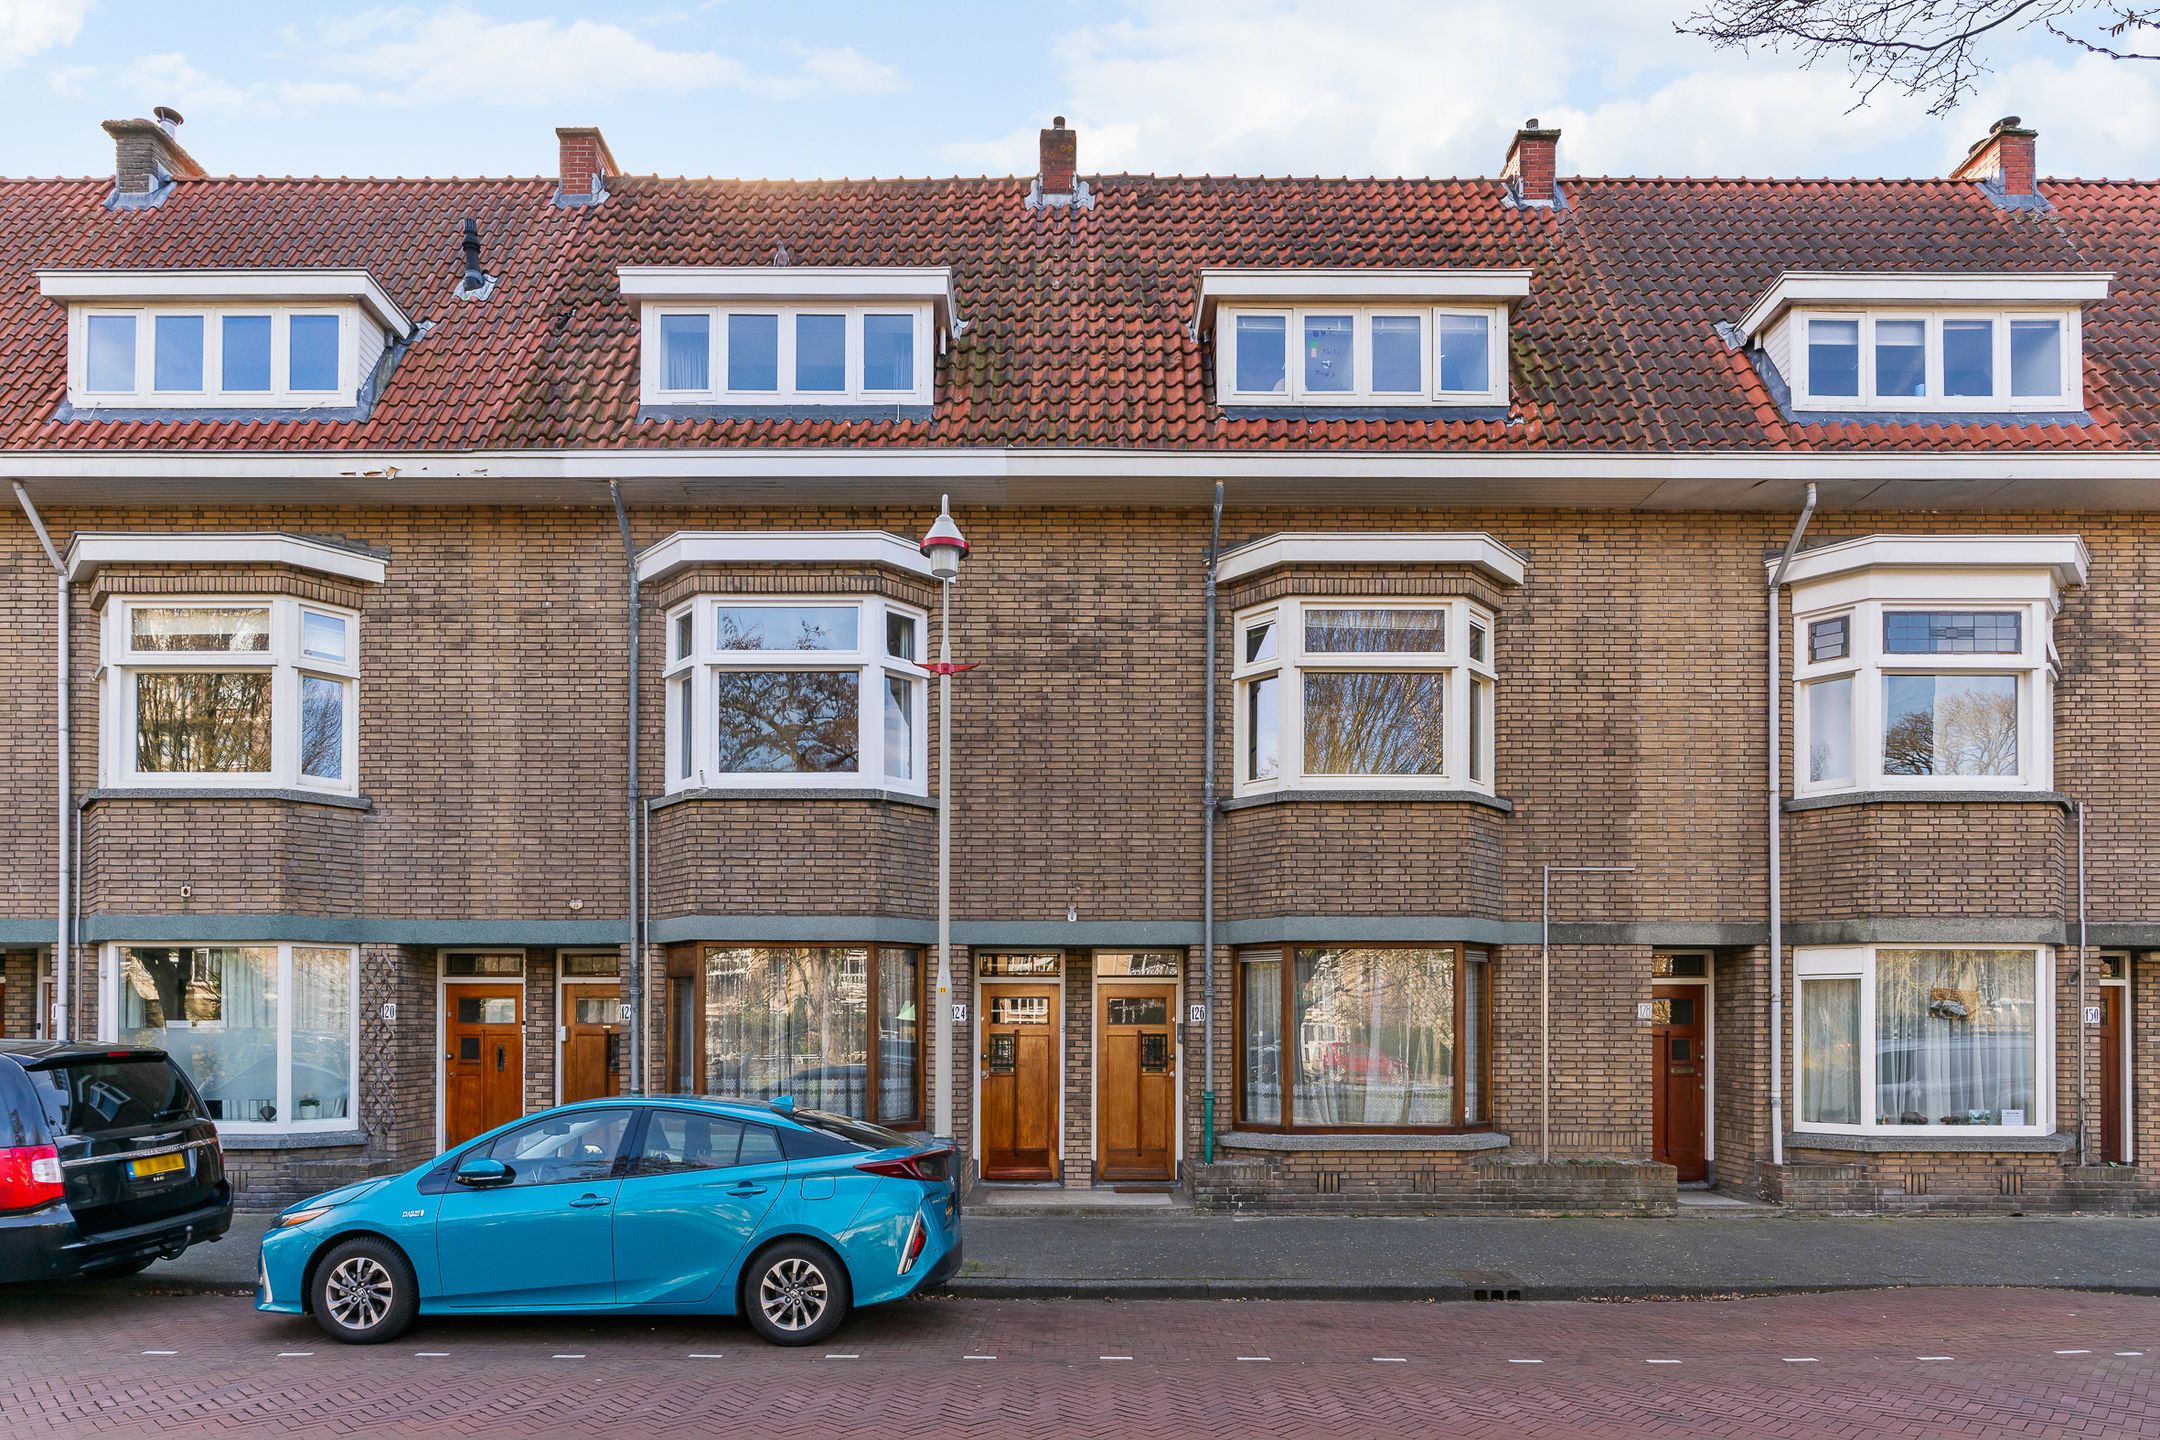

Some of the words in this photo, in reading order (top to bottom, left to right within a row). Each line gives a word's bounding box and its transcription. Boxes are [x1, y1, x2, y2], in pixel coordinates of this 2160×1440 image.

[622, 1006, 632, 1019] 12
[952, 1006, 965, 1019] 124
[1192, 1006, 1204, 1020] 126
